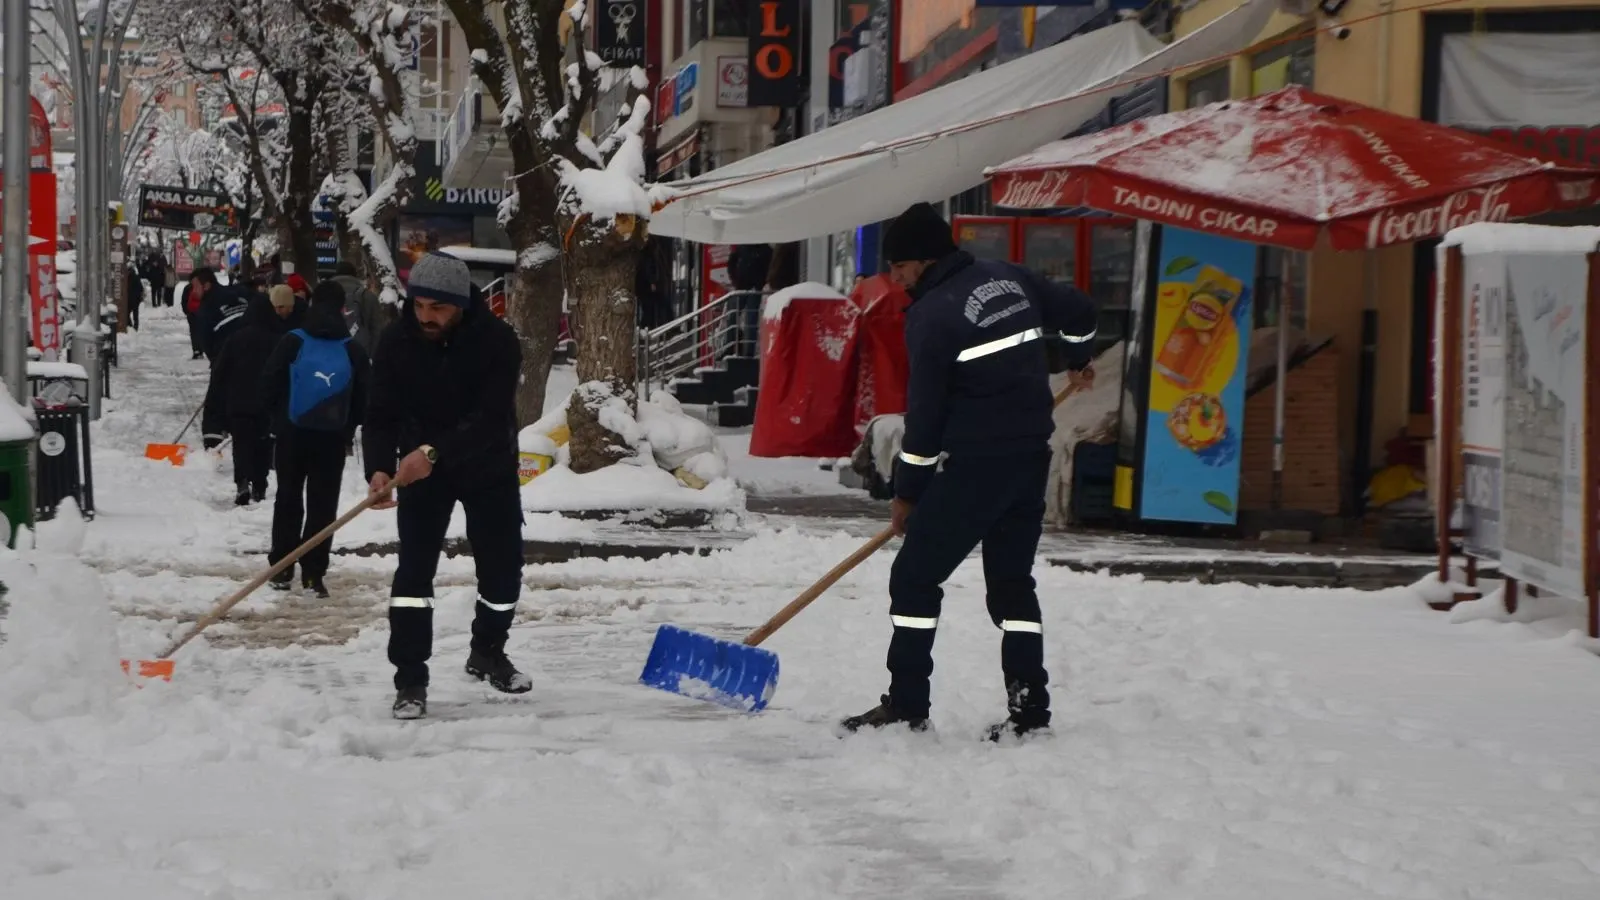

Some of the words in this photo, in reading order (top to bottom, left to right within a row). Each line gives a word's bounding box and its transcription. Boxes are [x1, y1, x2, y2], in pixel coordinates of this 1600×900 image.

[146, 190, 182, 205] AKSA
[185, 194, 217, 208] CAFE
[1113, 186, 1196, 221] TADINI
[1200, 208, 1278, 238] ÇIKAR
